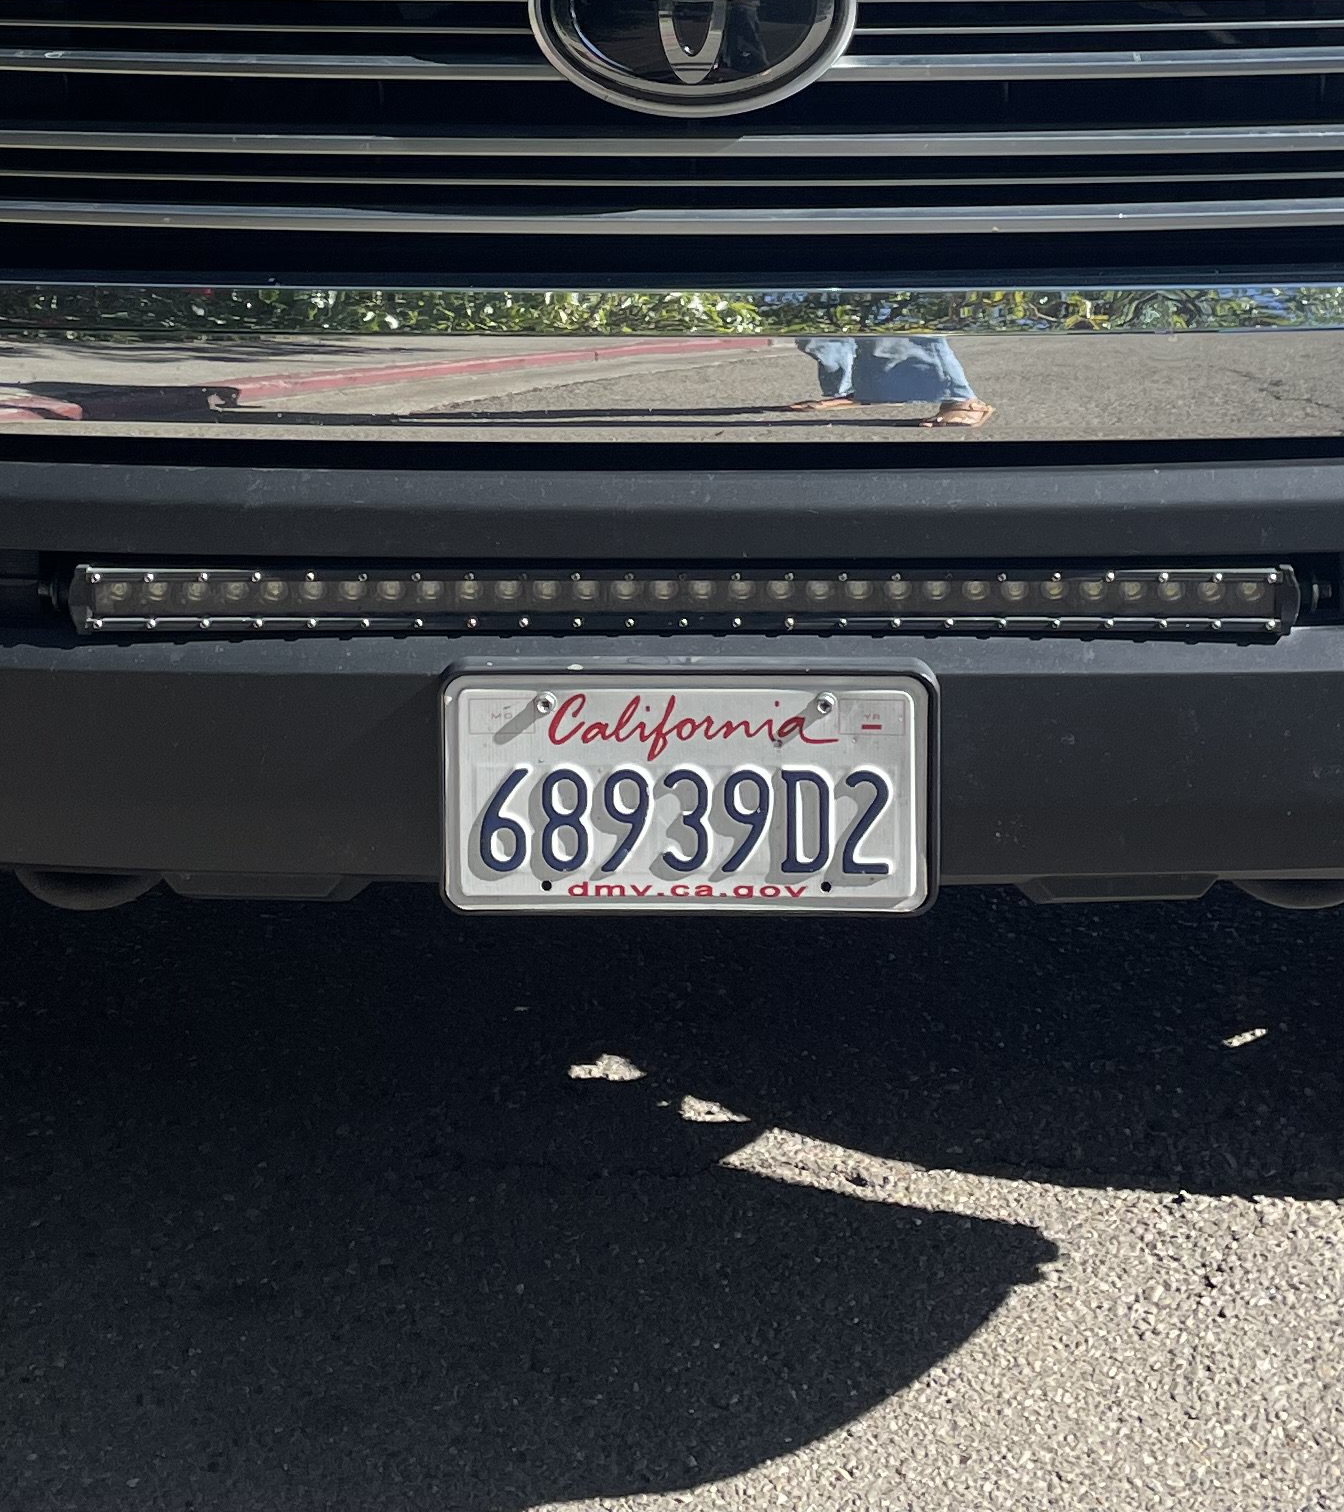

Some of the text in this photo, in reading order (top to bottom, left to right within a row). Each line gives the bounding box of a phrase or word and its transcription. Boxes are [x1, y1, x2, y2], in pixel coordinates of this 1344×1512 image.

[548, 693, 839, 762] California
[479, 767, 891, 875] 68939D2
[567, 881, 809, 899] dmv.ca.gov
